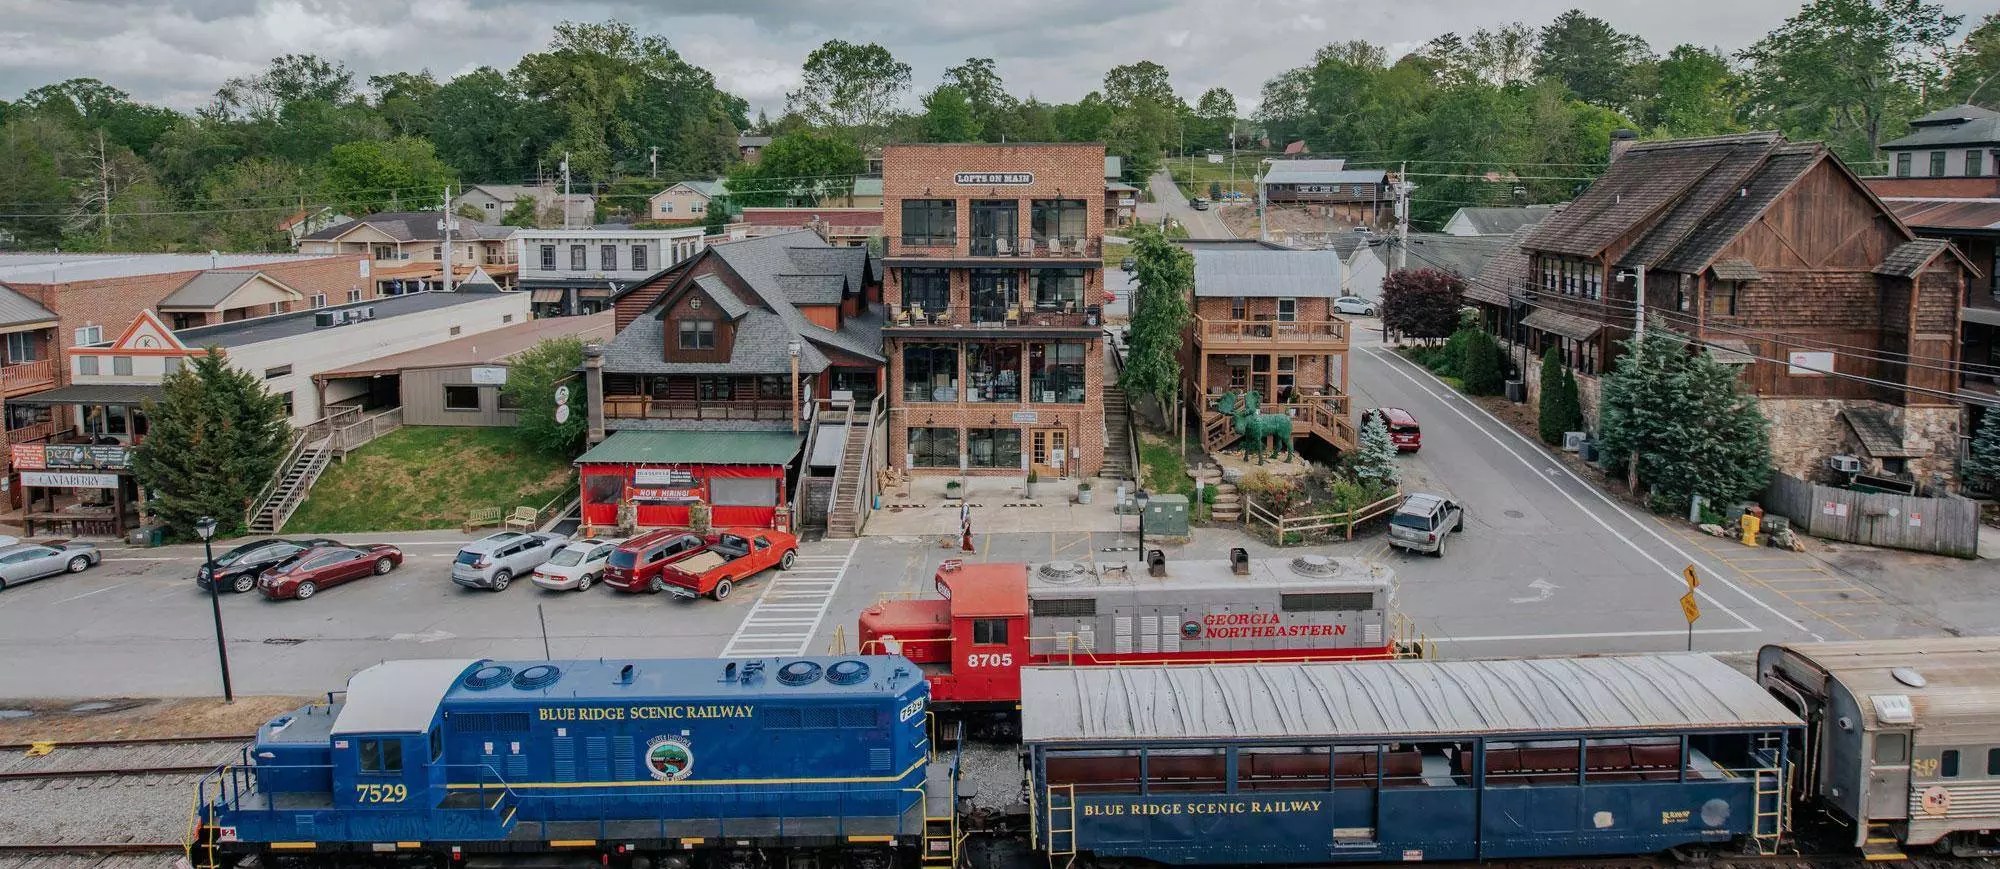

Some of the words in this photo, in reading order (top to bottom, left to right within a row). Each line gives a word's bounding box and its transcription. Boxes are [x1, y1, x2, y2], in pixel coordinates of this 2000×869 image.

[144, 338, 152, 347] K
[640, 489, 657, 497] NOW
[661, 489, 689, 497] HIRING!
[1203, 613, 1281, 626] GEORGIA
[1204, 624, 1347, 639] NORTHEASTERN
[967, 653, 1013, 668] 8705
[539, 708, 576, 721] BLUE
[578, 707, 625, 720] RIDGE
[630, 706, 684, 719] SCENIC
[686, 705, 754, 719] RAILWAY
[901, 699, 923, 720] 7529
[356, 784, 408, 803] 7529
[1084, 804, 1124, 816] BLUE
[1131, 803, 1181, 815] RIDGE
[1187, 802, 1245, 814] SCENIC
[1251, 800, 1322, 813] RAILWAY
